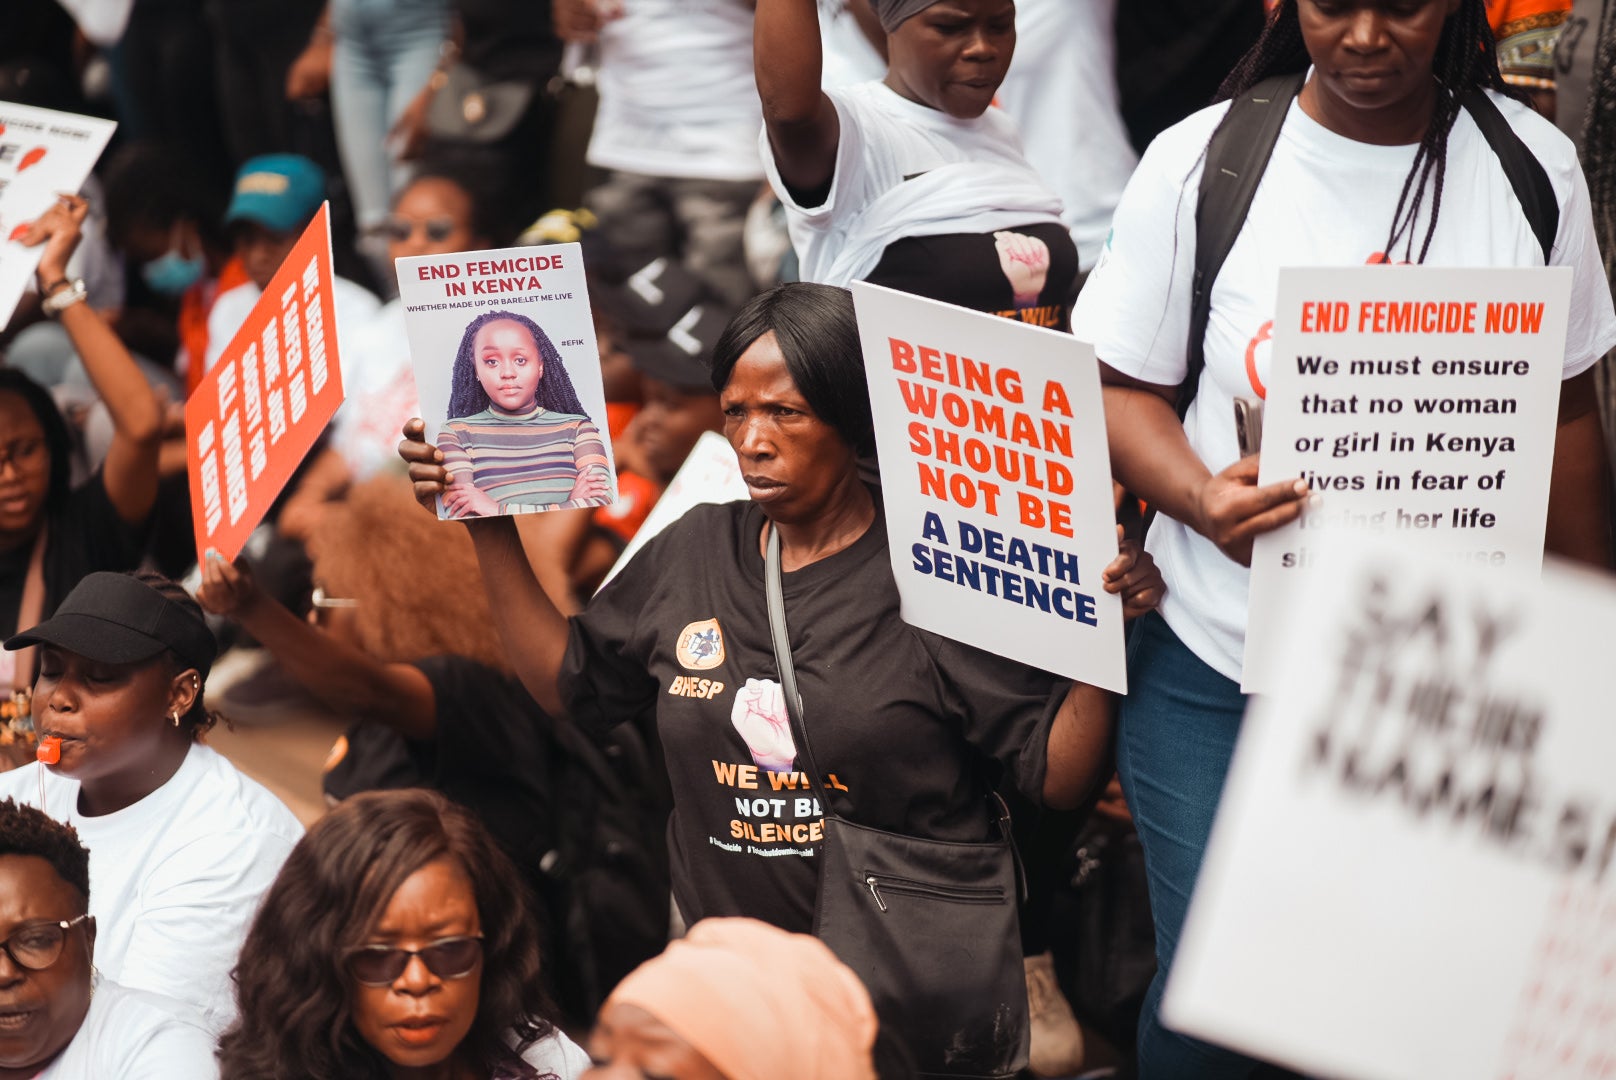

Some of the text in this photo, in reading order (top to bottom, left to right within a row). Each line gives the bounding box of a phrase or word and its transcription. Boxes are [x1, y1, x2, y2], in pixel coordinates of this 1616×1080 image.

[418, 255, 564, 281] END FEMICIDE
[407, 303, 447, 312] WHETHER
[449, 301, 473, 309] MADE
[475, 299, 486, 307] UP
[487, 298, 499, 306] OR
[541, 294, 553, 302] ME
[554, 292, 573, 301] LIVE
[445, 276, 542, 297] IN KENYA
[302, 254, 328, 396] WE DEMAND
[1300, 301, 1545, 334] END FEMICIDE NOW
[281, 281, 307, 425] A SAFER AND
[561, 338, 584, 347] #EFIK
[262, 315, 286, 446] MORE JUST
[888, 336, 1074, 418] BEING A
[1296, 356, 1530, 376] We must ensure
[242, 341, 267, 482] SOCIETY FOR
[897, 378, 1074, 458] WOMAN
[1300, 394, 1517, 414] that no woman
[217, 359, 248, 527] ALL WOMEN
[907, 421, 1074, 496] SHOULD
[1295, 432, 1516, 458] or girl in Kenya
[198, 418, 222, 538] IN KENYA
[1376, 471, 1400, 490] in
[1411, 469, 1468, 490] fear
[1477, 469, 1506, 490] of
[917, 461, 1074, 538] NOT BE
[1395, 508, 1443, 529] her
[1452, 507, 1496, 528] life
[922, 511, 1080, 585] A DEATH
[912, 542, 1098, 627] SENTENCE
[668, 675, 725, 699] BHESP
[712, 759, 849, 793] WE WIL
[735, 797, 786, 818] NOT
[730, 818, 825, 843] SILENCE
